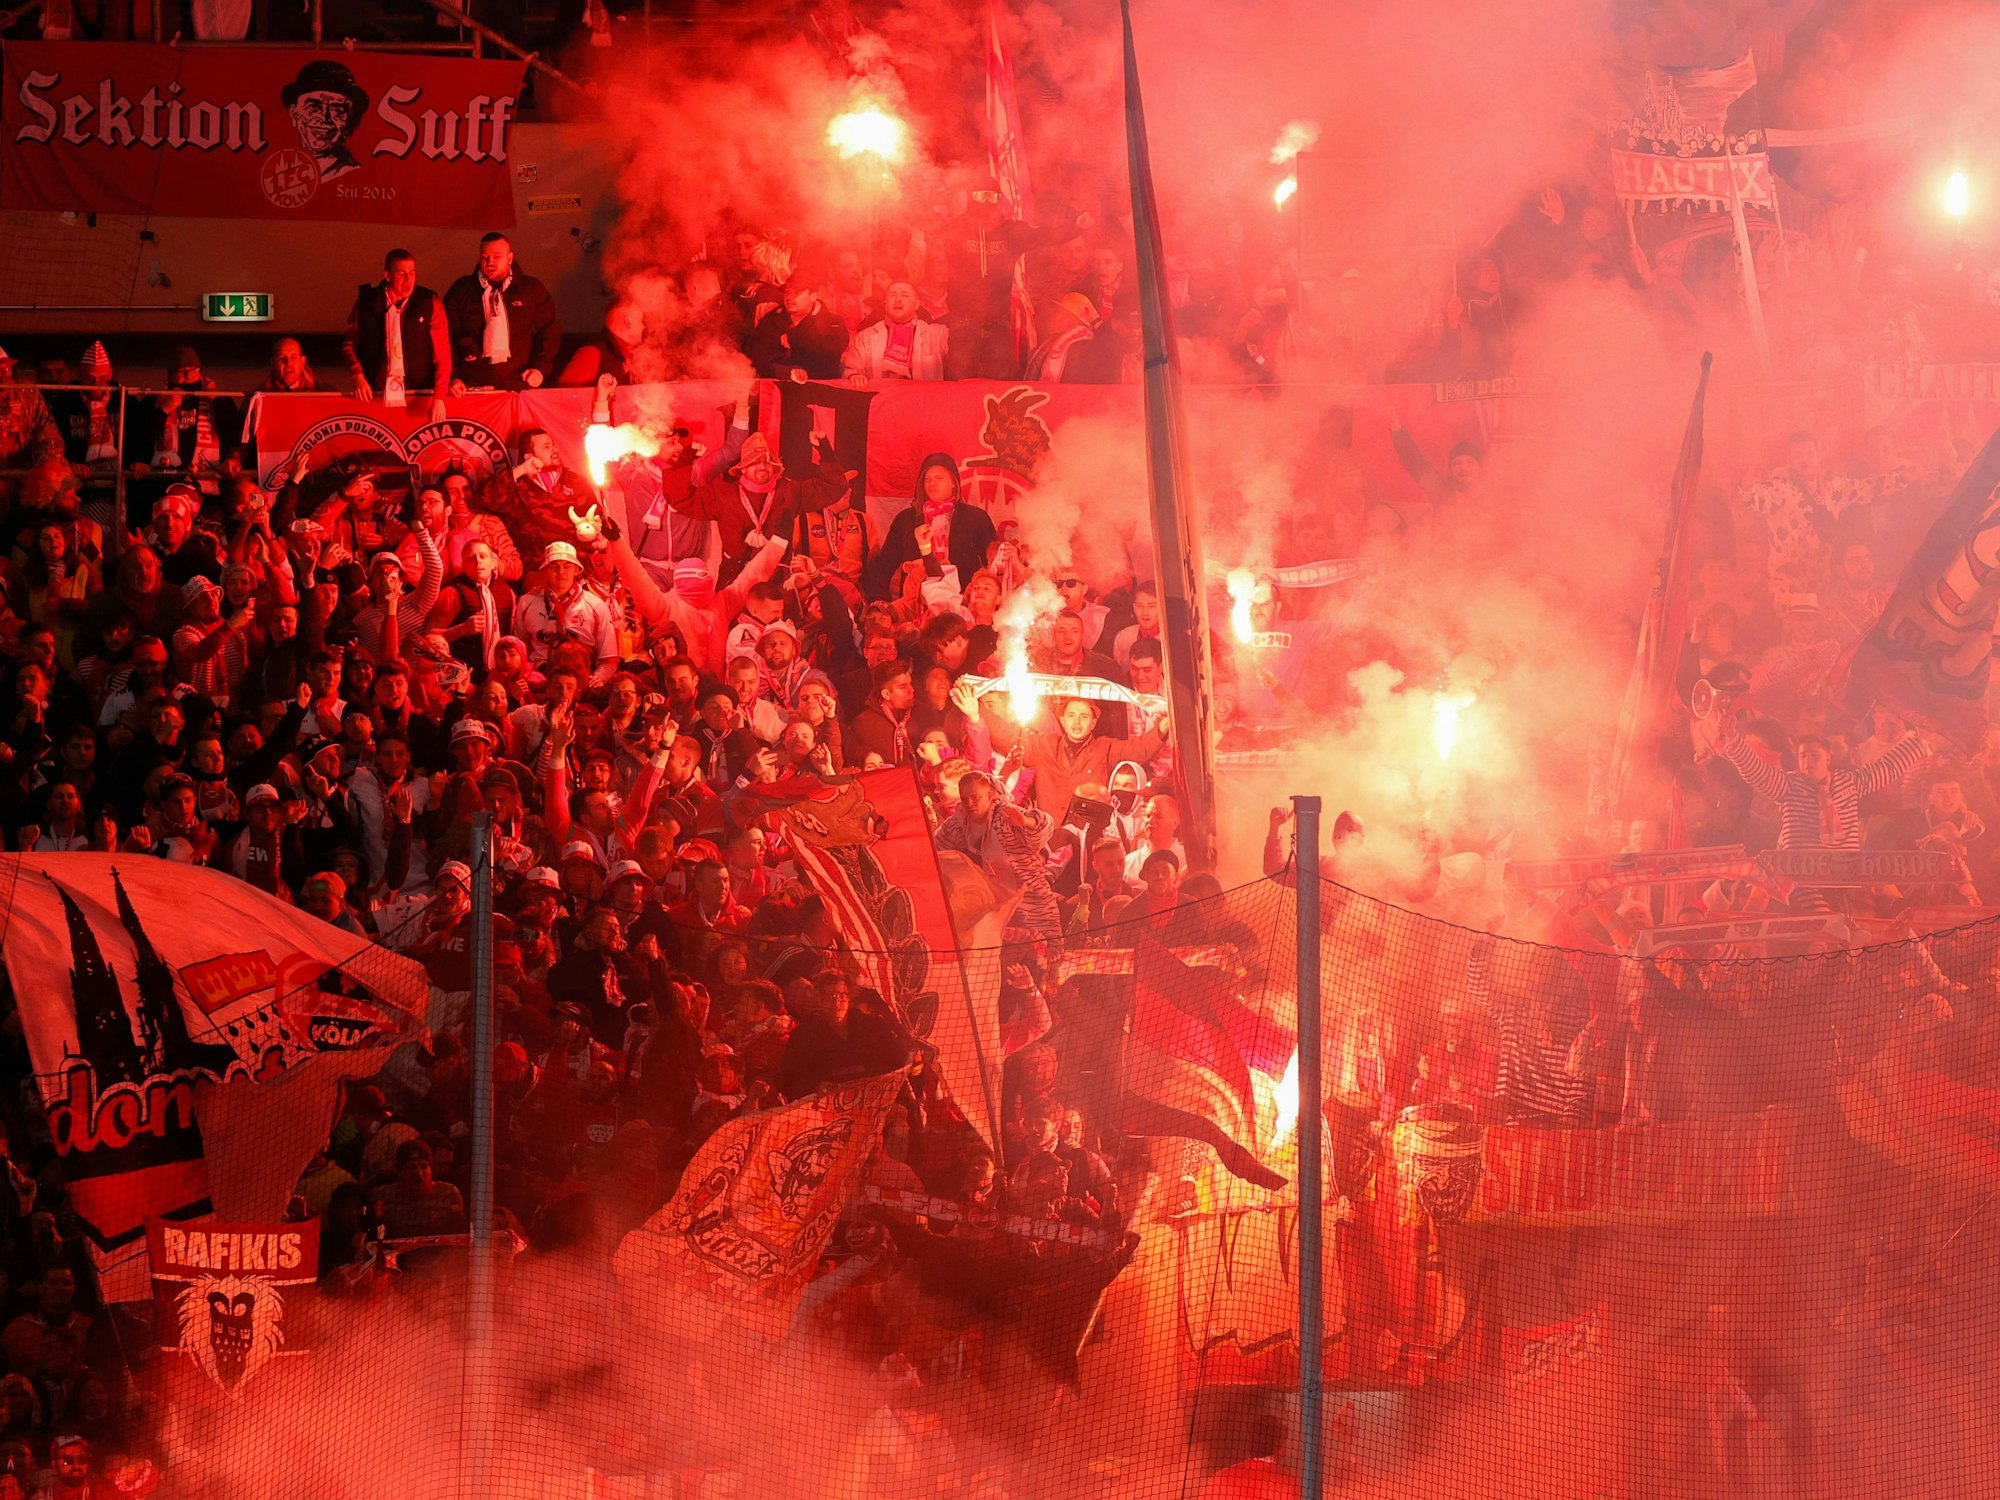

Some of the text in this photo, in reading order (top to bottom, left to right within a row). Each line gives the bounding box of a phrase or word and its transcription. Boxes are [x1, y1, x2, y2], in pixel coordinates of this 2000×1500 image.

[15, 70, 516, 163] Sektion Suff
[362, 186, 396, 200] 2010
[345, 422, 393, 450] POLONIA
[164, 1227, 303, 1270] RAFIKIS
